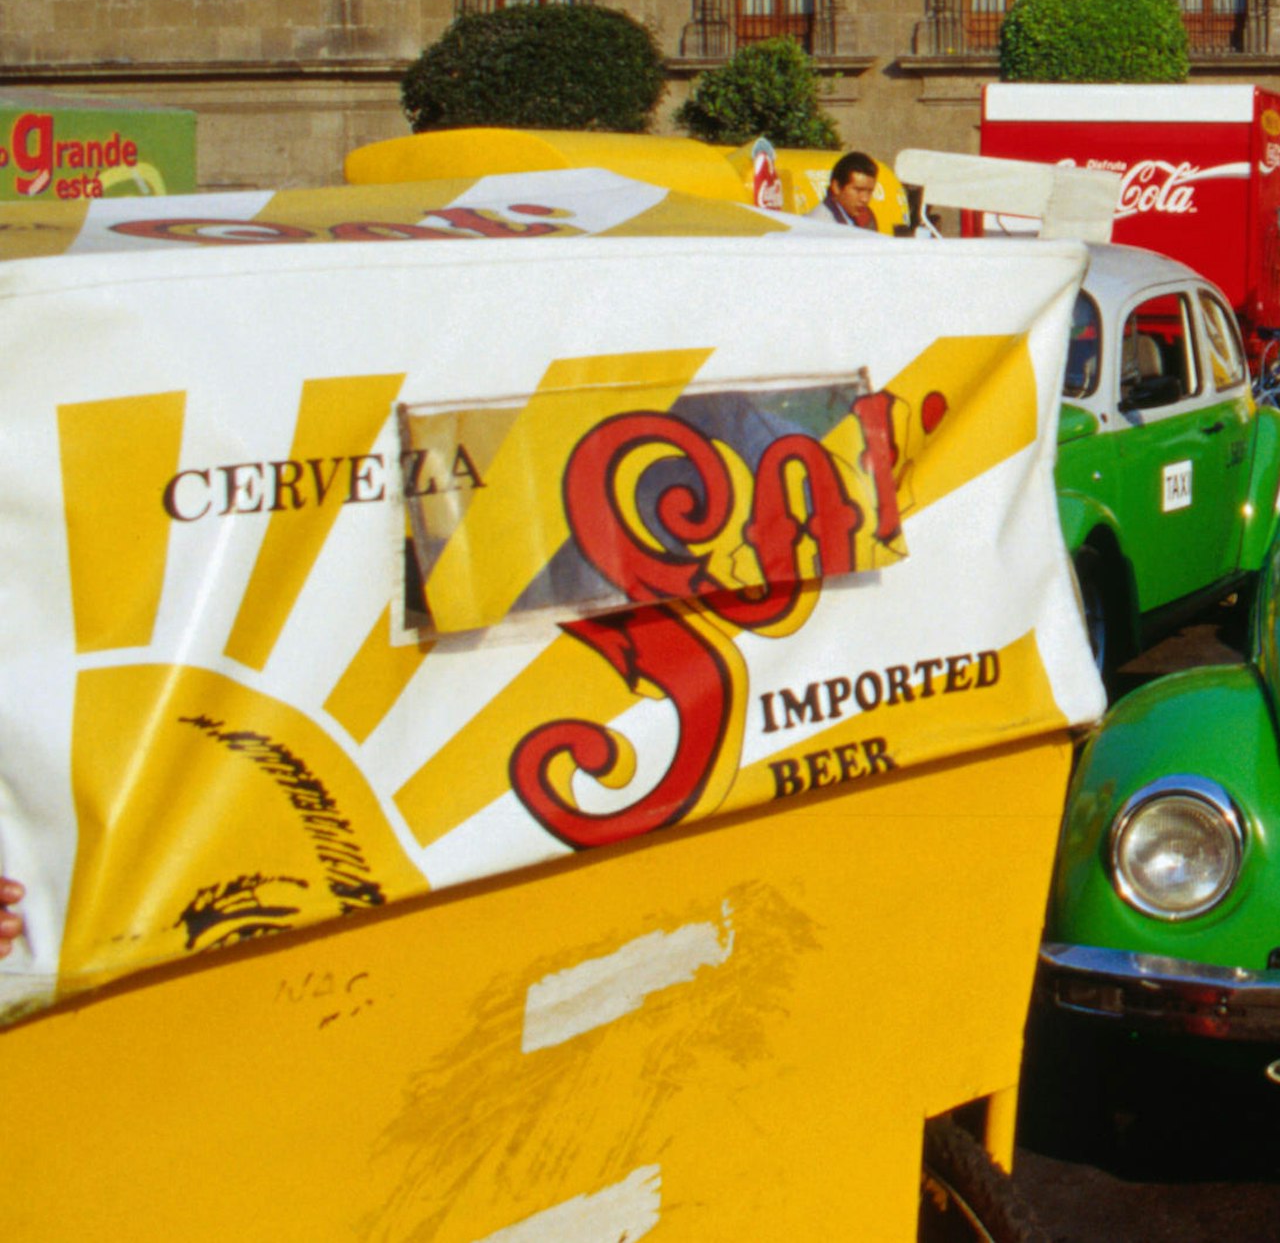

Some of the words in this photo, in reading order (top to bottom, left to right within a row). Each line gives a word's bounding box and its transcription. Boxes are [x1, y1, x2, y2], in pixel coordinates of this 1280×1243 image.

[12, 112, 138, 196] grande
[56, 170, 104, 199] está
[161, 443, 487, 522] CERVEZA
[760, 649, 1001, 734] IMPORTED
[768, 736, 899, 800] BEER
